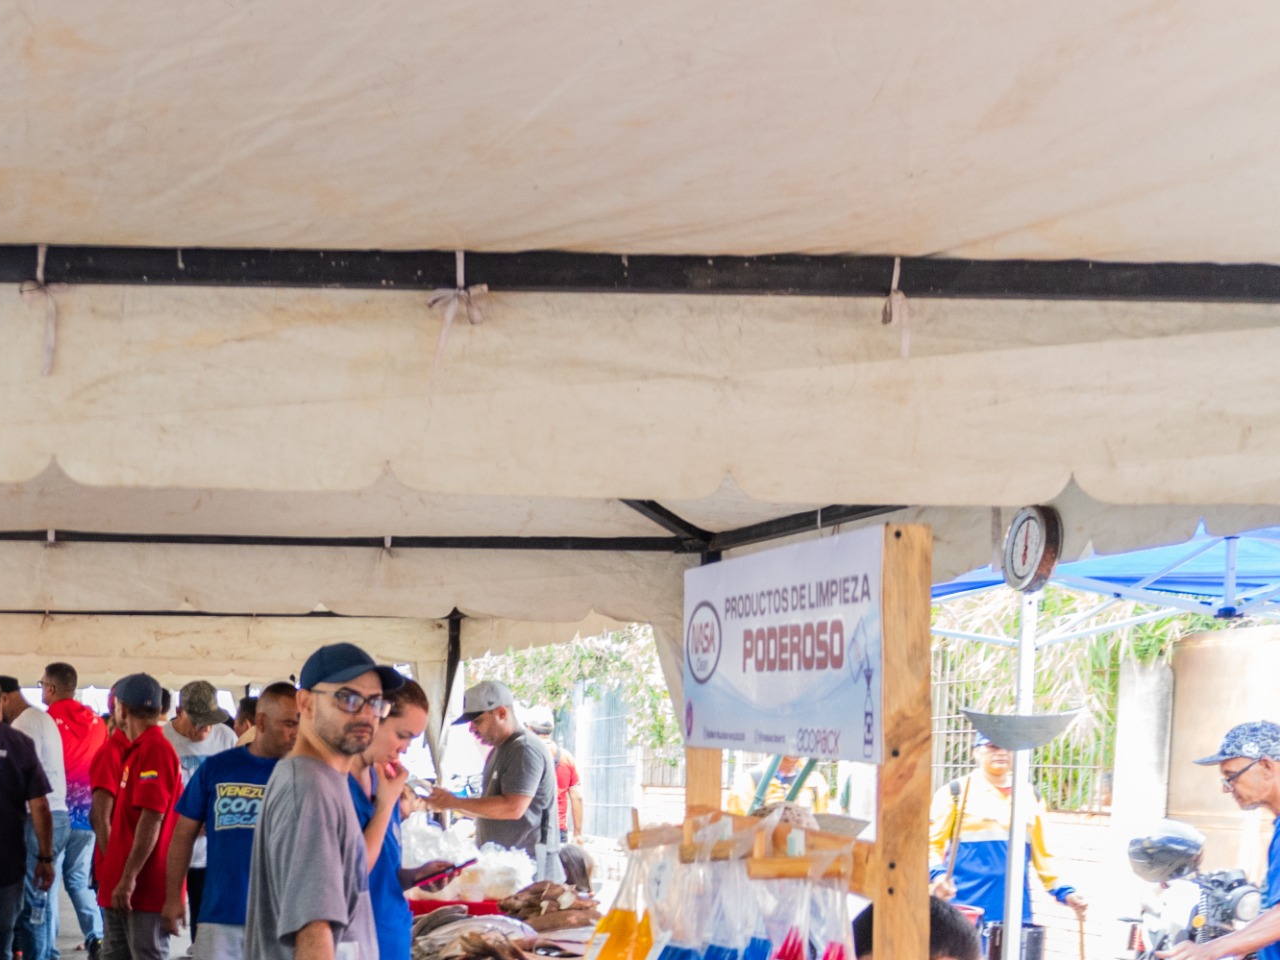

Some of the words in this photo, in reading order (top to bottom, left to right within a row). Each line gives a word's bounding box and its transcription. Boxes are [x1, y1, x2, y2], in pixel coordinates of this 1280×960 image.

[724, 586, 789, 620] PRODUCTOS
[791, 583, 806, 612] DE
[808, 573, 871, 609] LIMPIEZA
[692, 620, 716, 655] NASA
[742, 619, 844, 673] PODEROSO
